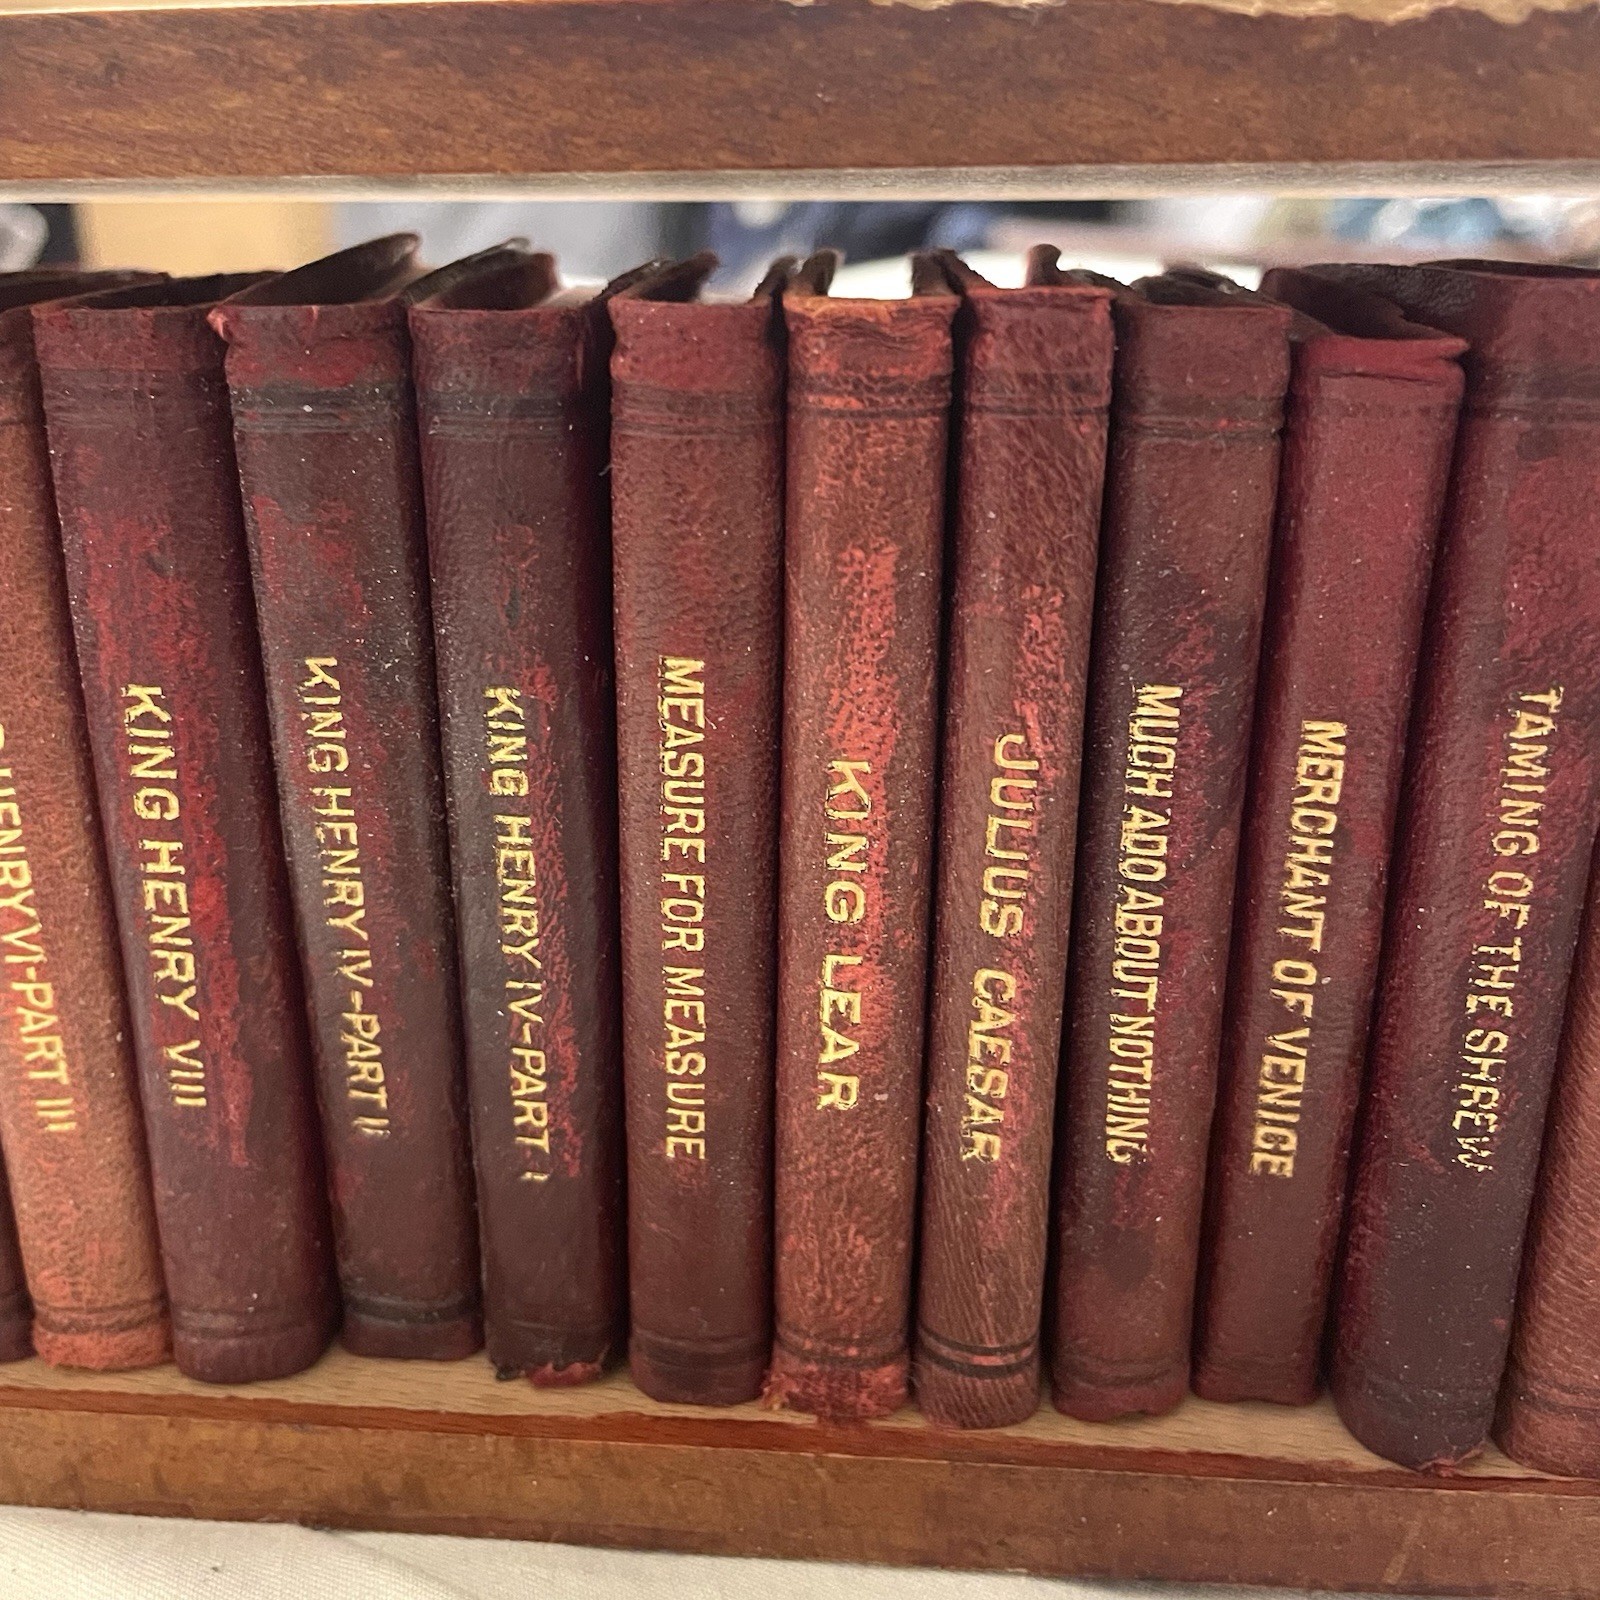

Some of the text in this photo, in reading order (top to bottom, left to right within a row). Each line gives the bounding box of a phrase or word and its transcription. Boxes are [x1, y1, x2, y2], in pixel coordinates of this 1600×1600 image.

[120, 683, 207, 1107] KING HENRY VIII
[300, 656, 349, 774] KING
[309, 787, 369, 941] HENRY
[485, 687, 529, 797] KING
[494, 814, 542, 969] HENRY
[657, 655, 707, 1160] MEASURE FOR MEASURE
[30, 1096, 78, 1133] III
[816, 760, 872, 1111] KING LEAR
[960, 733, 1040, 1163] JULIUS CAESAR
[1105, 683, 1184, 1164] MUCH ADO ABOUT NOTHING
[1252, 720, 1348, 1178] MERCHANT OF VENICE
[1452, 686, 1562, 1173] TAMING OF THE SHREW
